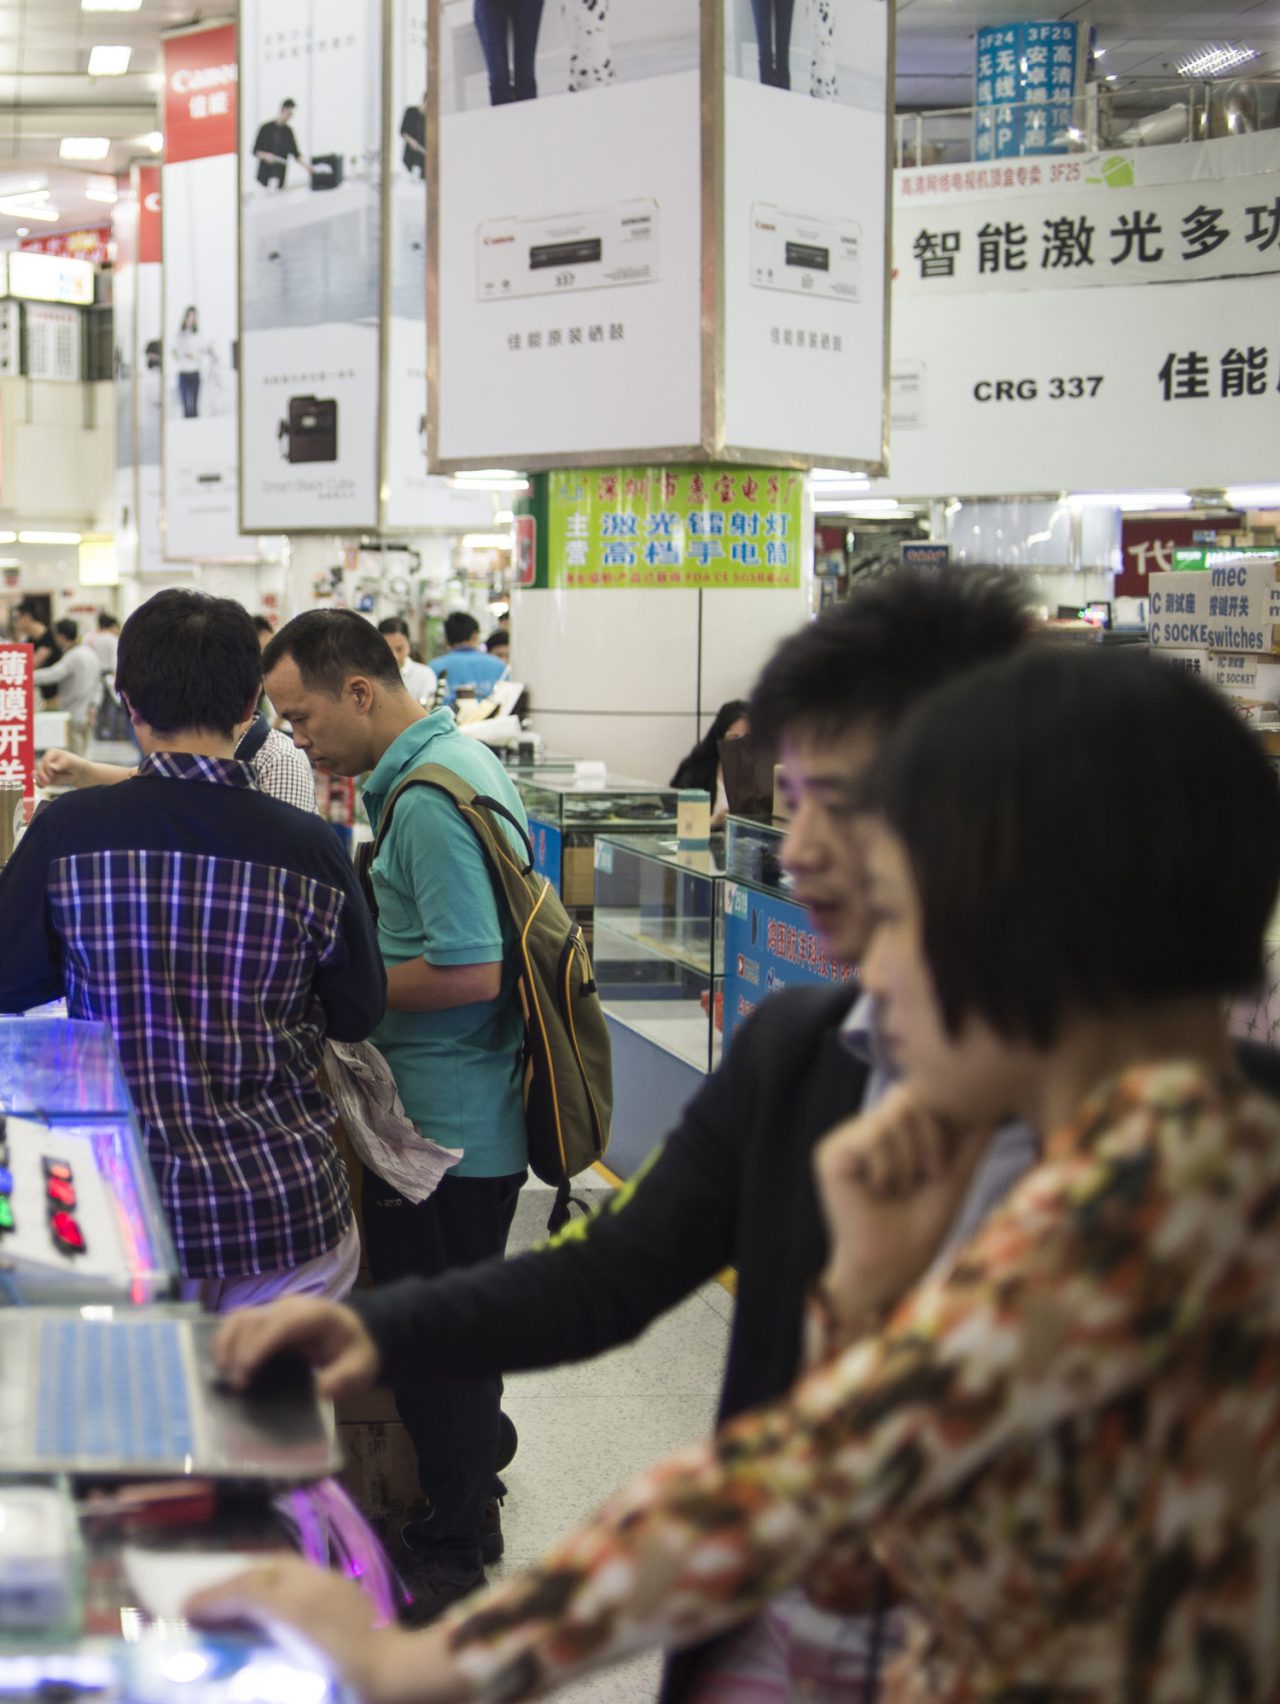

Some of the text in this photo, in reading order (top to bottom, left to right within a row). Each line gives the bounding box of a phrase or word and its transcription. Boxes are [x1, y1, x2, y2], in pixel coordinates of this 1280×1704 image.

[1028, 27, 1072, 41] 3F25
[1049, 162, 1081, 183] 3F25
[913, 196, 1280, 279] 智能激光多功
[507, 321, 625, 351] 佳能原装硒鼓
[1158, 345, 1280, 402] 佳能
[973, 376, 1105, 402] CRG 337
[600, 511, 791, 537] 激光镭射灯
[565, 511, 589, 566] 主营
[600, 540, 789, 566] 高档手电筒
[1211, 567, 1248, 588] mec
[1165, 593, 1195, 614] 测试座
[1209, 595, 1249, 617] 按键开关
[1164, 624, 1208, 643] SOCKE
[1208, 626, 1264, 649] switches
[1227, 674, 1255, 684] SOCKET
